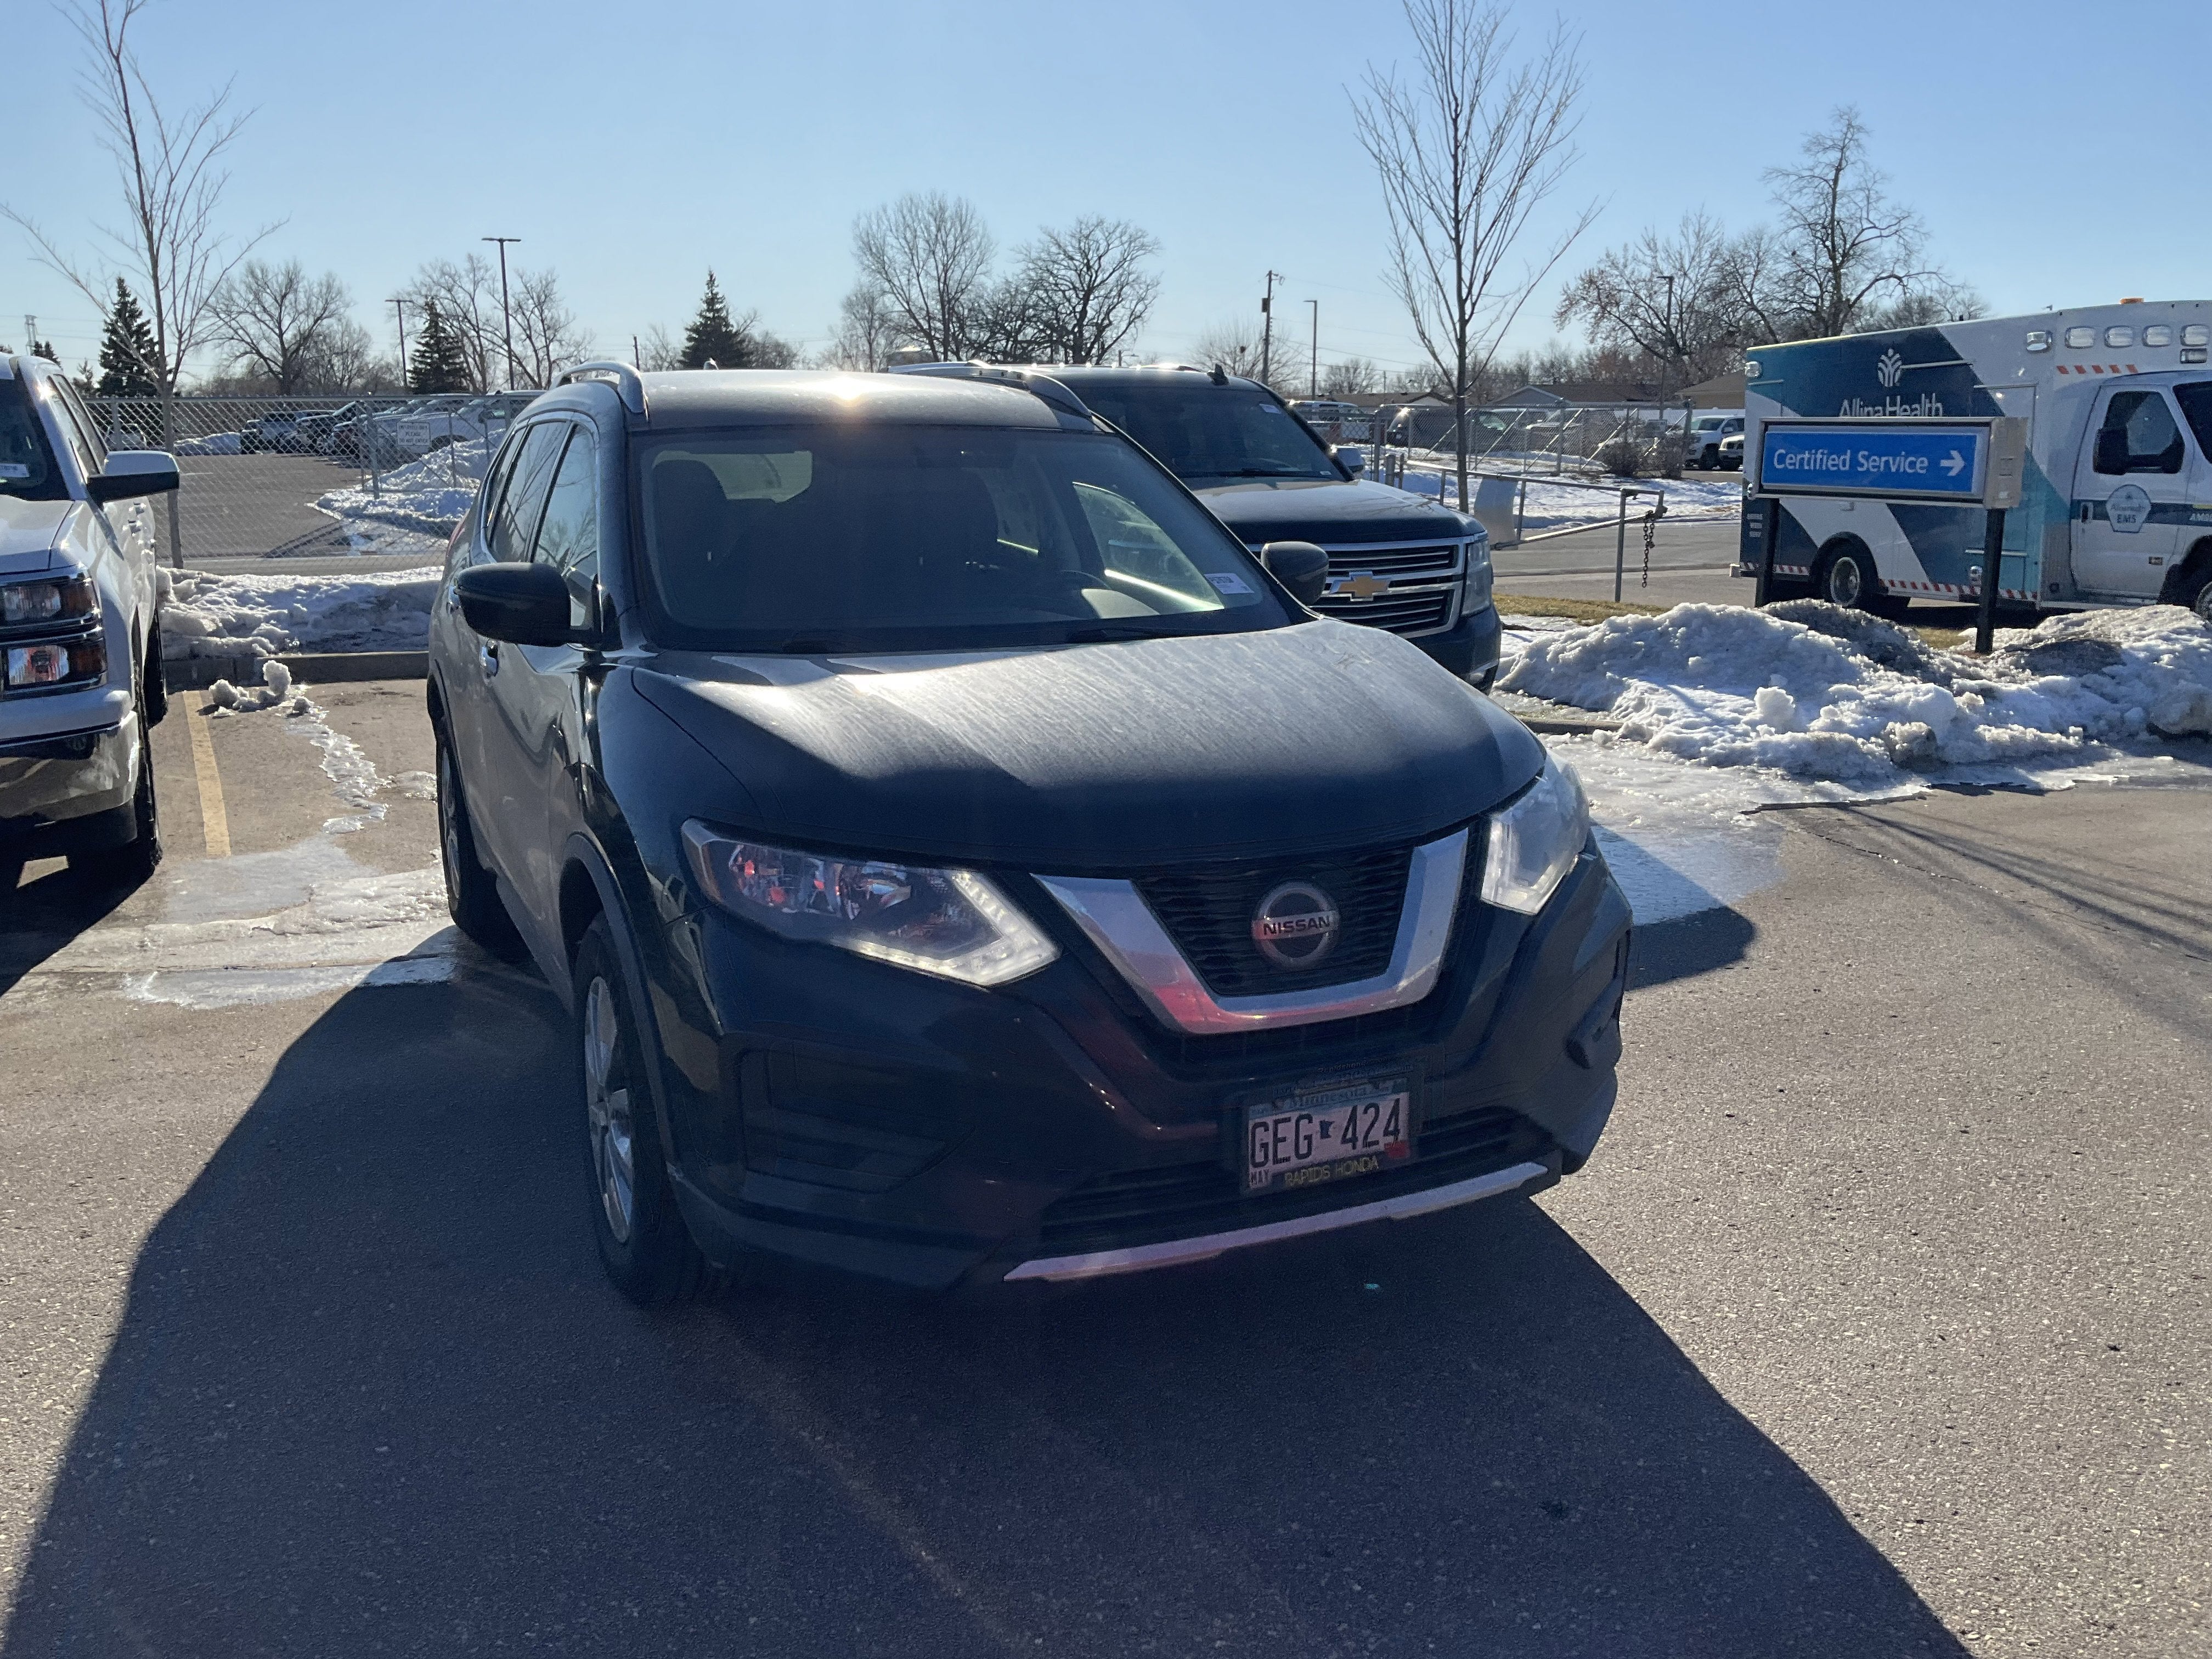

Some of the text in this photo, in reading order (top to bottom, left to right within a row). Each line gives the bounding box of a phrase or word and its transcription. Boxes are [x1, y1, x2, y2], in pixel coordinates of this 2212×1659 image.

[1773, 449, 1929, 475] Certified Service
[2117, 514, 2136, 523] EMS
[1263, 916, 1330, 935] NISSAN
[1250, 1098, 1401, 1169] GEG 424
[1284, 1155, 1380, 1186] RAPIDS HONDA
